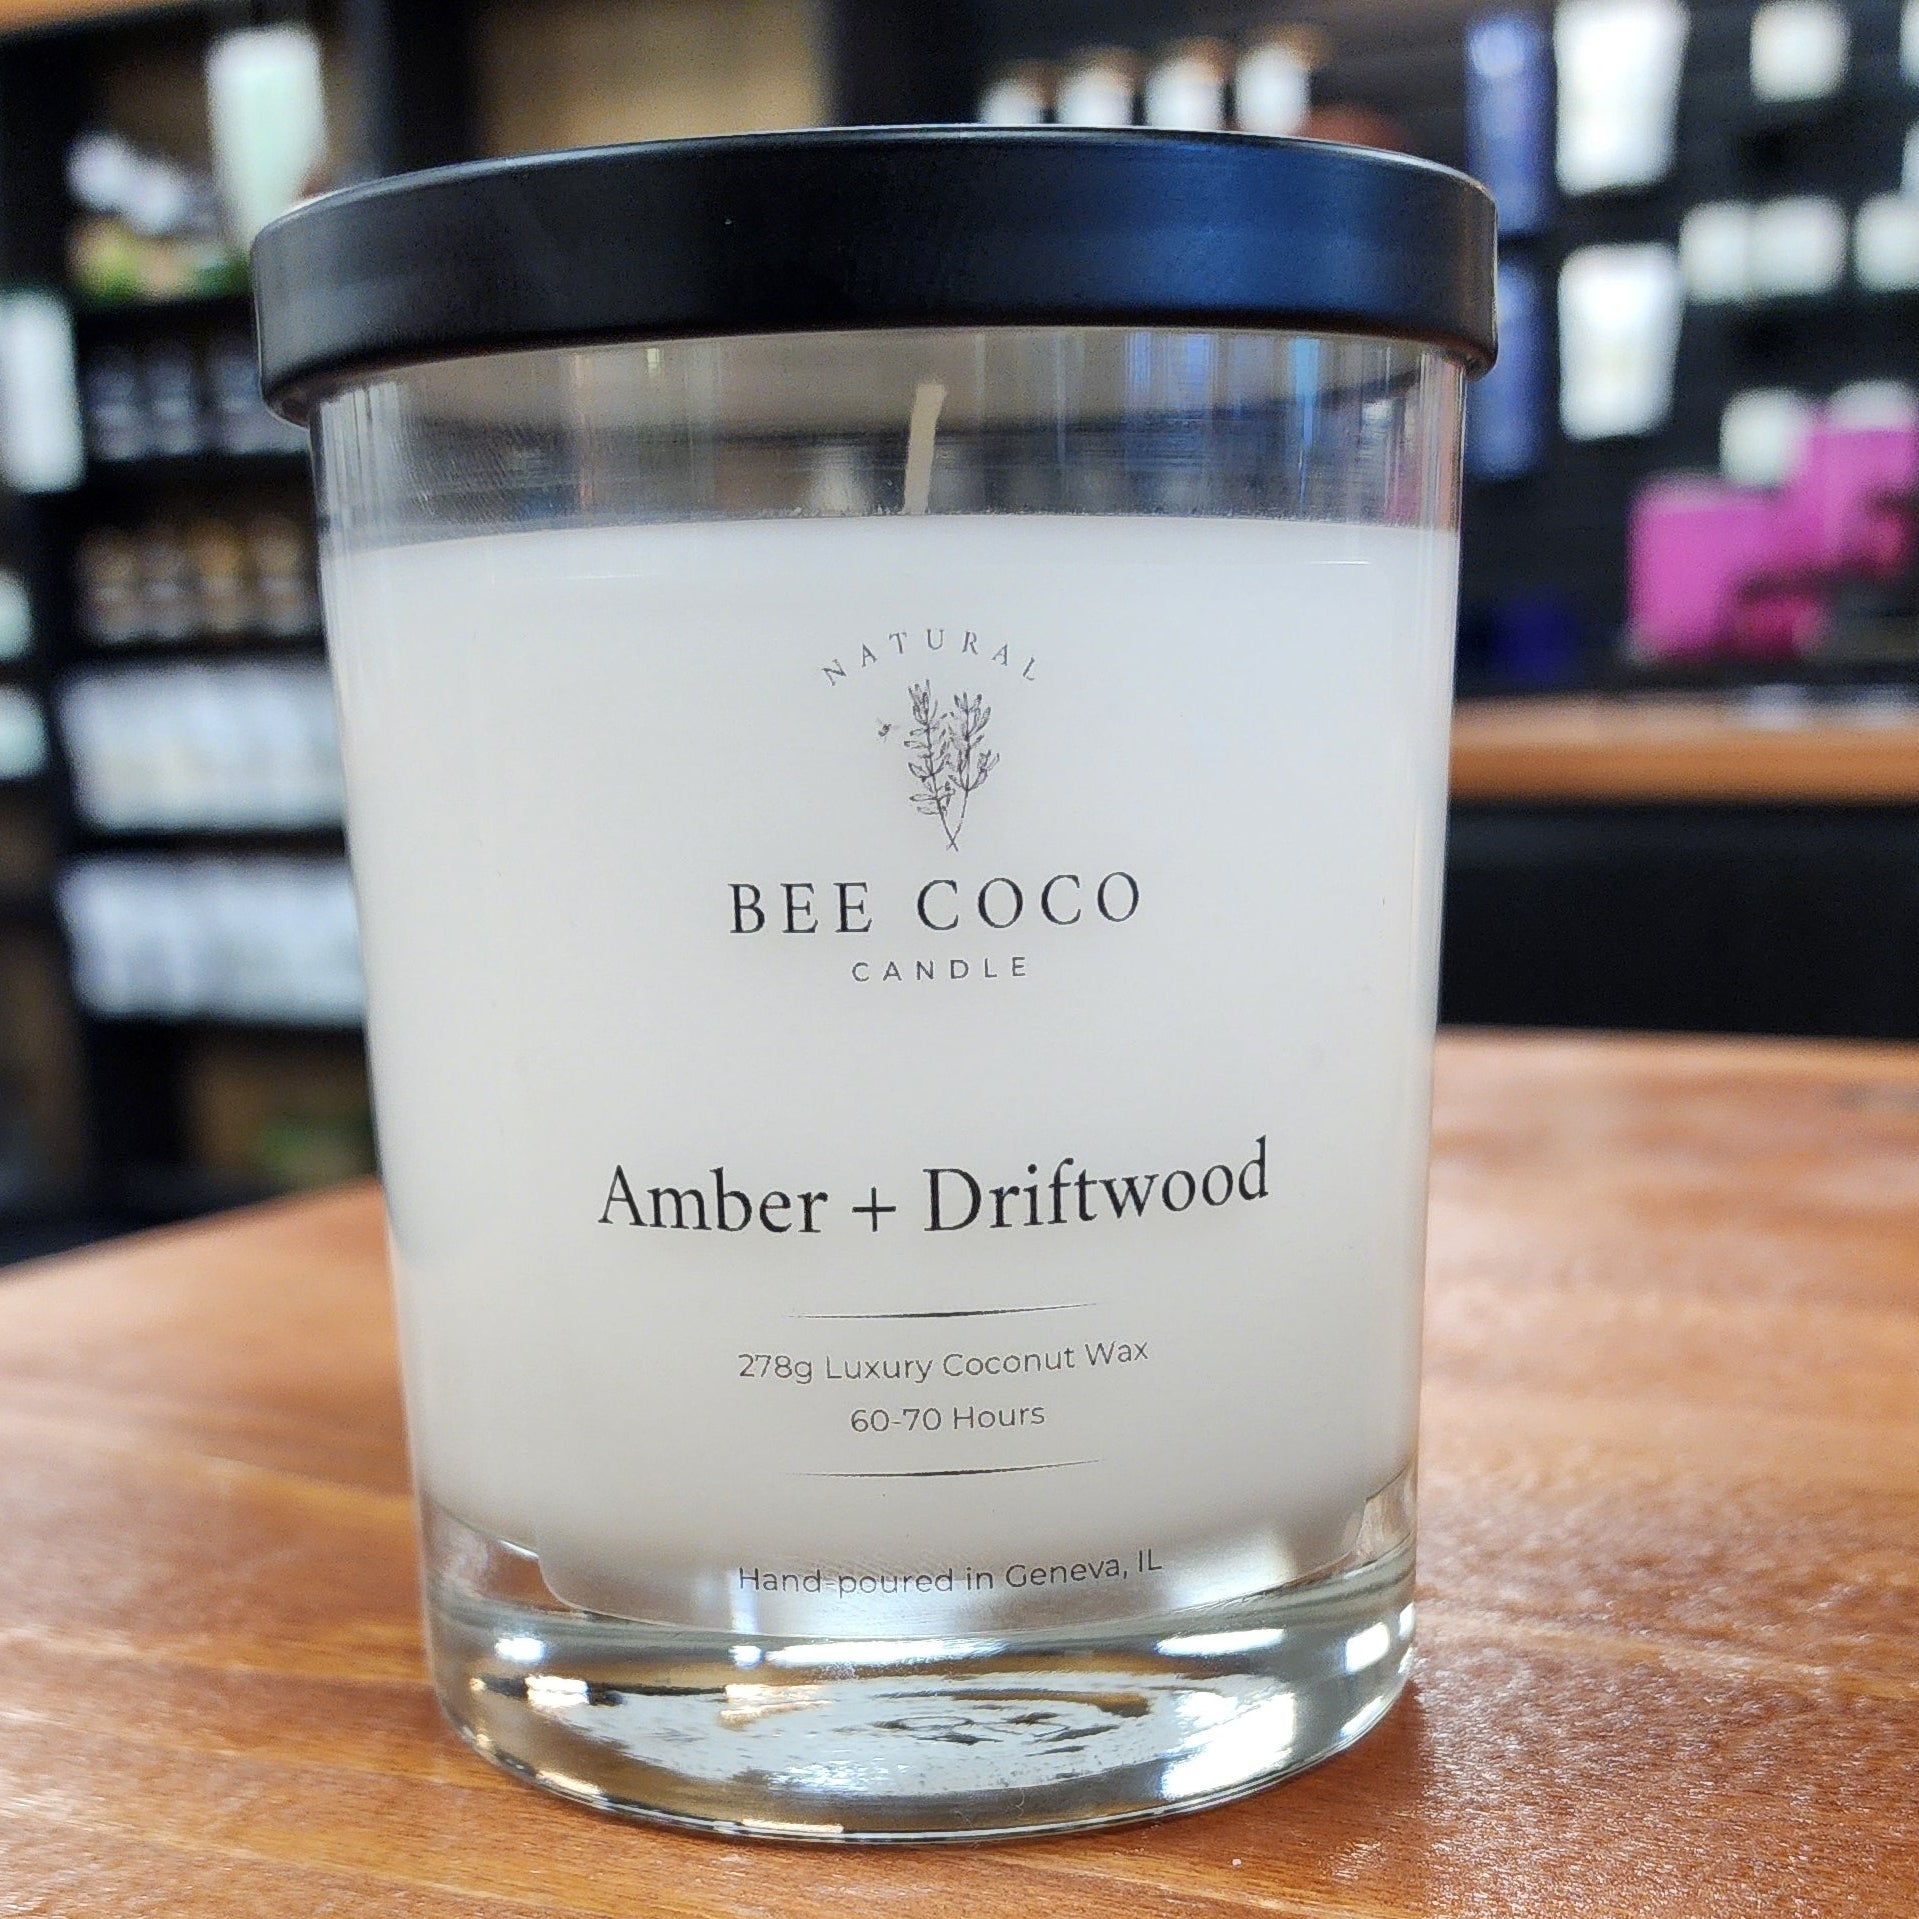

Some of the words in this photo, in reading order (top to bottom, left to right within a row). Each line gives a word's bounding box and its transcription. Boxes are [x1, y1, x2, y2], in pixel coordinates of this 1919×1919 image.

[821, 628, 1038, 687] NATURAL
[727, 881, 873, 934] BEE
[916, 871, 1140, 931] COCO
[851, 956, 1027, 983] CANDLE
[597, 1164, 829, 1235] Amber
[851, 1185, 897, 1233] +
[922, 1134, 1270, 1232] Driftwood
[737, 1353, 813, 1385] 278g
[826, 1355, 934, 1384] Luxury
[942, 1347, 1076, 1377] Coconut
[1084, 1340, 1149, 1367] Wax
[850, 1407, 942, 1433] 60-70
[953, 1405, 1045, 1430] Hours
[738, 1565, 953, 1600] Hand-poured
[965, 1566, 994, 1591] in
[1005, 1558, 1128, 1588] Geneva,
[1138, 1548, 1163, 1573] IL
